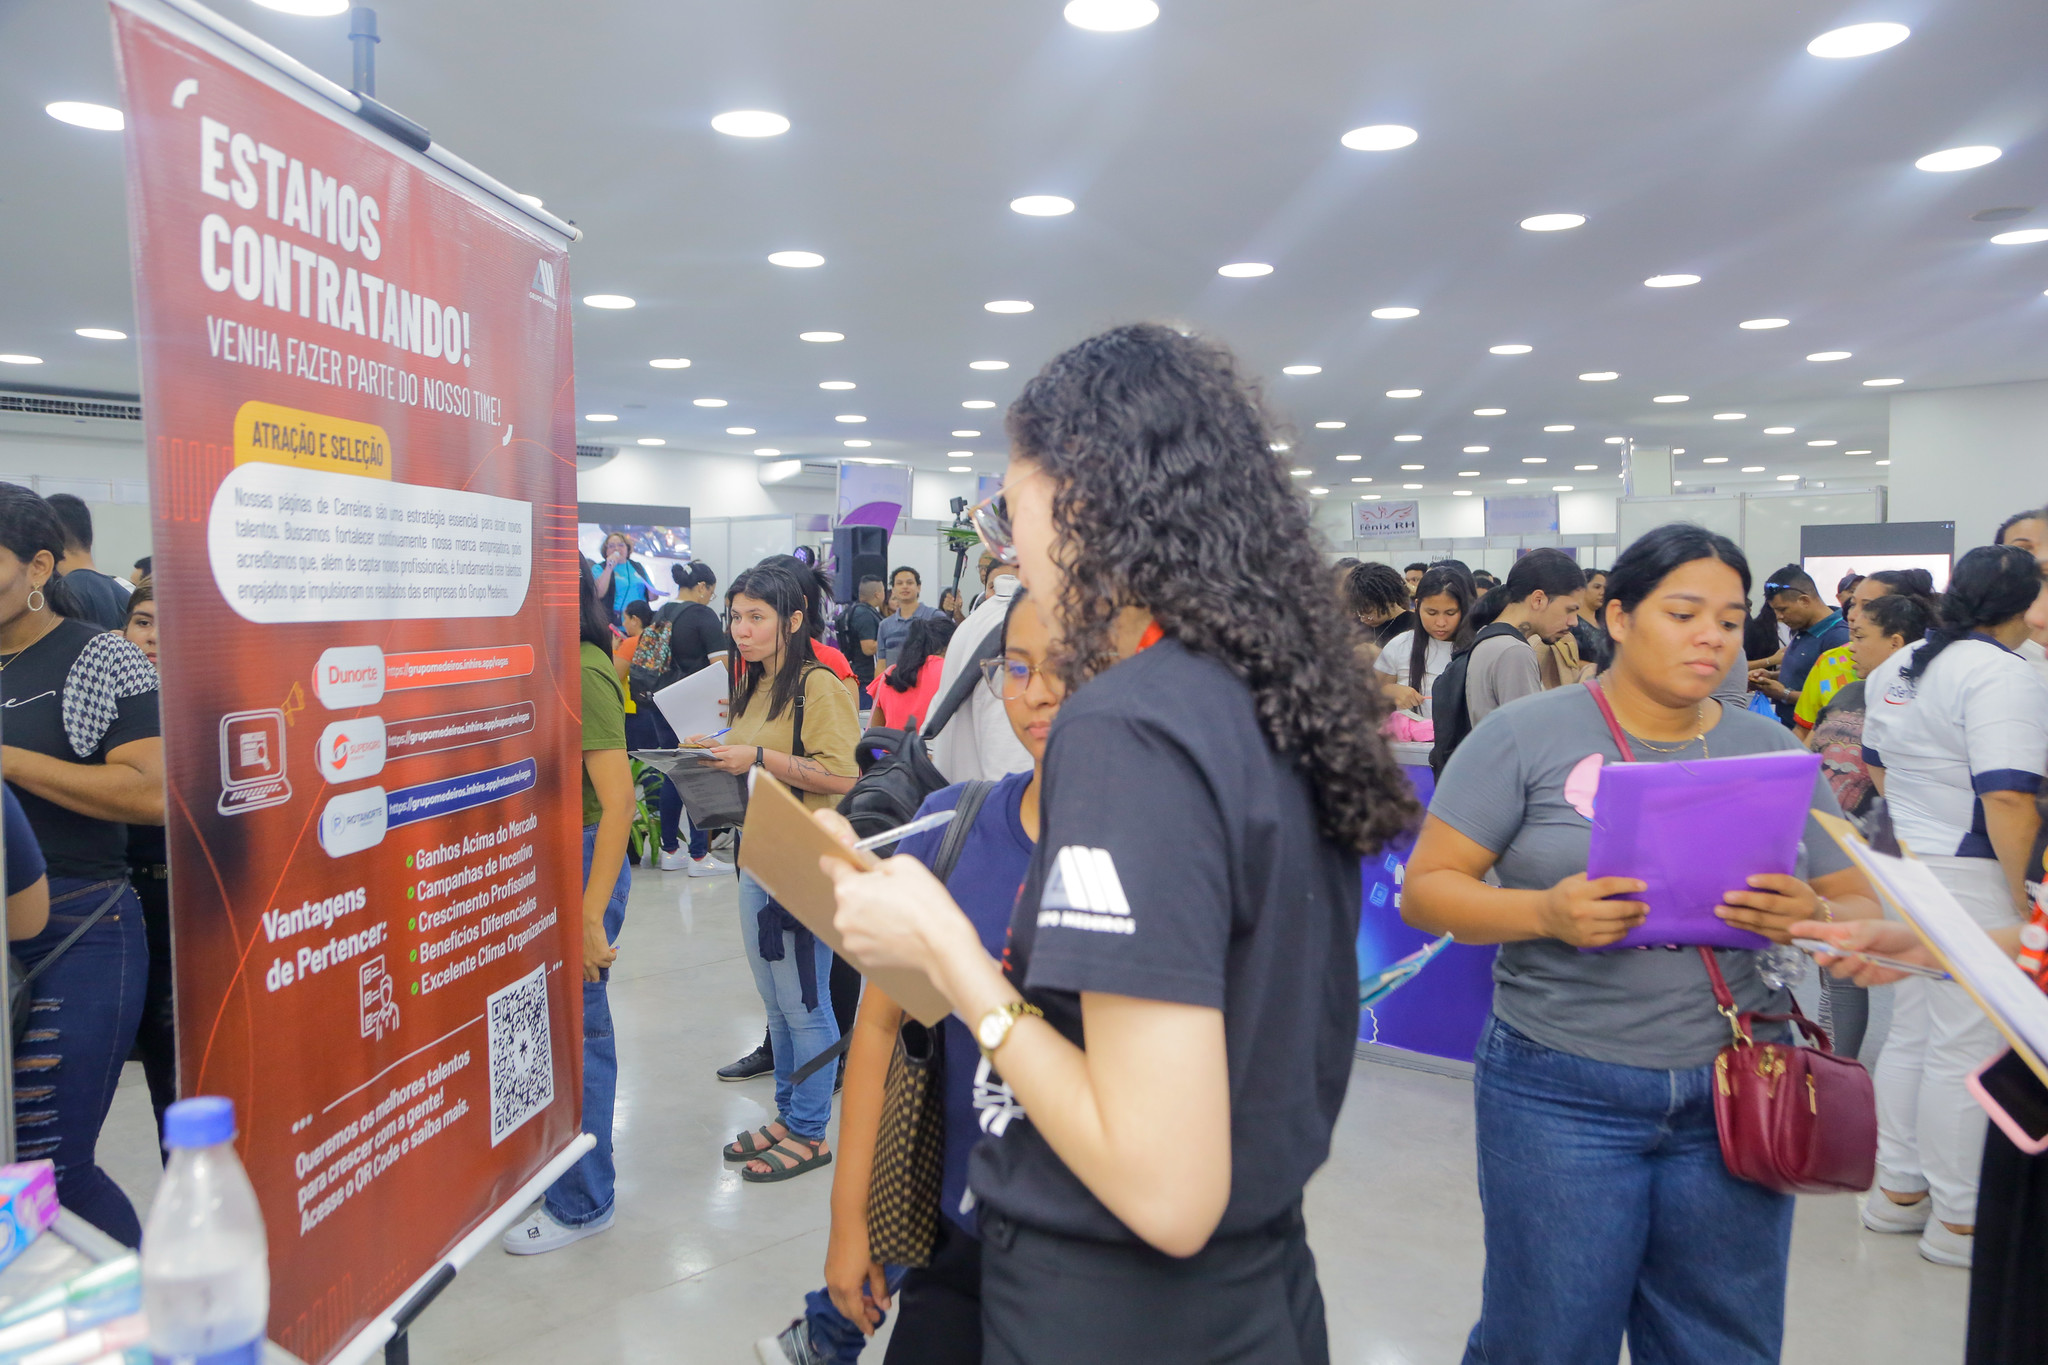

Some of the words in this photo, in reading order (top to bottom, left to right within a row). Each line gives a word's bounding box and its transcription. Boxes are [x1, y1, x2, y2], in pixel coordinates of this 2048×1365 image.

[201, 115, 381, 261] ESTAMOS
[201, 214, 471, 367] CONTRATANDO!
[207, 315, 281, 373] VENHA
[287, 338, 342, 387] FAZER
[348, 354, 396, 400] PARTE
[400, 371, 418, 406] DO
[424, 377, 471, 418] NOSSO
[474, 390, 501, 426] TIME!
[252, 421, 315, 459] ATRAÇÃO
[320, 434, 327, 455] E
[331, 436, 384, 470] SELEÇÃO
[235, 487, 273, 508] Nossas
[278, 493, 312, 516] páginas
[317, 496, 329, 514] de
[334, 497, 372, 518] Carreiras
[407, 509, 446, 528] estratégia
[449, 513, 478, 528] essencial
[235, 519, 280, 539] talentos.
[284, 521, 331, 543] Buscamos
[335, 525, 375, 545] fortalecer
[432, 536, 451, 551] nossa
[455, 538, 477, 552] marca
[1395, 521, 1415, 529] RH
[236, 550, 297, 570] acreditamos
[299, 555, 318, 574] que,
[321, 553, 342, 571] além
[345, 554, 356, 572] de
[358, 557, 381, 576] captar
[401, 558, 449, 576] profissionais,
[451, 560, 455, 574] é
[456, 560, 494, 576] fundamental
[238, 580, 288, 604] engajados
[290, 584, 306, 602] que
[308, 581, 364, 603] impulsionam
[365, 585, 374, 599] os
[408, 583, 421, 599] das
[423, 585, 457, 602] empresas
[458, 584, 467, 599] do
[468, 584, 486, 601] Grupo
[328, 665, 378, 685] Dunorte
[387, 656, 508, 677] https://grupomedeiros.inhire.app/vagas
[415, 839, 461, 871] Ganhos
[462, 830, 495, 857] Acima
[496, 827, 508, 848] do
[508, 814, 537, 843] Mercado
[417, 864, 484, 902] Campanhas
[485, 857, 498, 878] de
[499, 845, 533, 871] Incentivo
[418, 893, 490, 933] Crescimento
[491, 866, 536, 903] Profissional
[262, 886, 366, 943] Vantagens
[420, 926, 479, 964] Benefícios
[481, 895, 537, 935] Diferenciados
[266, 957, 295, 993] de
[297, 921, 388, 980] Pertencer:
[421, 955, 477, 996] Excelente
[478, 942, 506, 967] Clima
[507, 907, 557, 953] Organizacional
[296, 1120, 359, 1179] Queremos
[360, 1112, 375, 1132] os
[375, 1076, 426, 1122] melhores
[427, 1050, 470, 1088] talentos
[298, 1172, 327, 1212] para
[328, 1137, 374, 1183] crescer
[375, 1120, 397, 1148] com
[397, 1114, 406, 1131] a
[407, 1085, 445, 1126] gente!
[300, 1186, 345, 1237] Acesse
[345, 1179, 354, 1198] o
[355, 1163, 374, 1193] QR
[373, 1142, 400, 1178] Code
[401, 1137, 409, 1153] e
[410, 1117, 443, 1150] saiba
[443, 1097, 470, 1126] mais.
